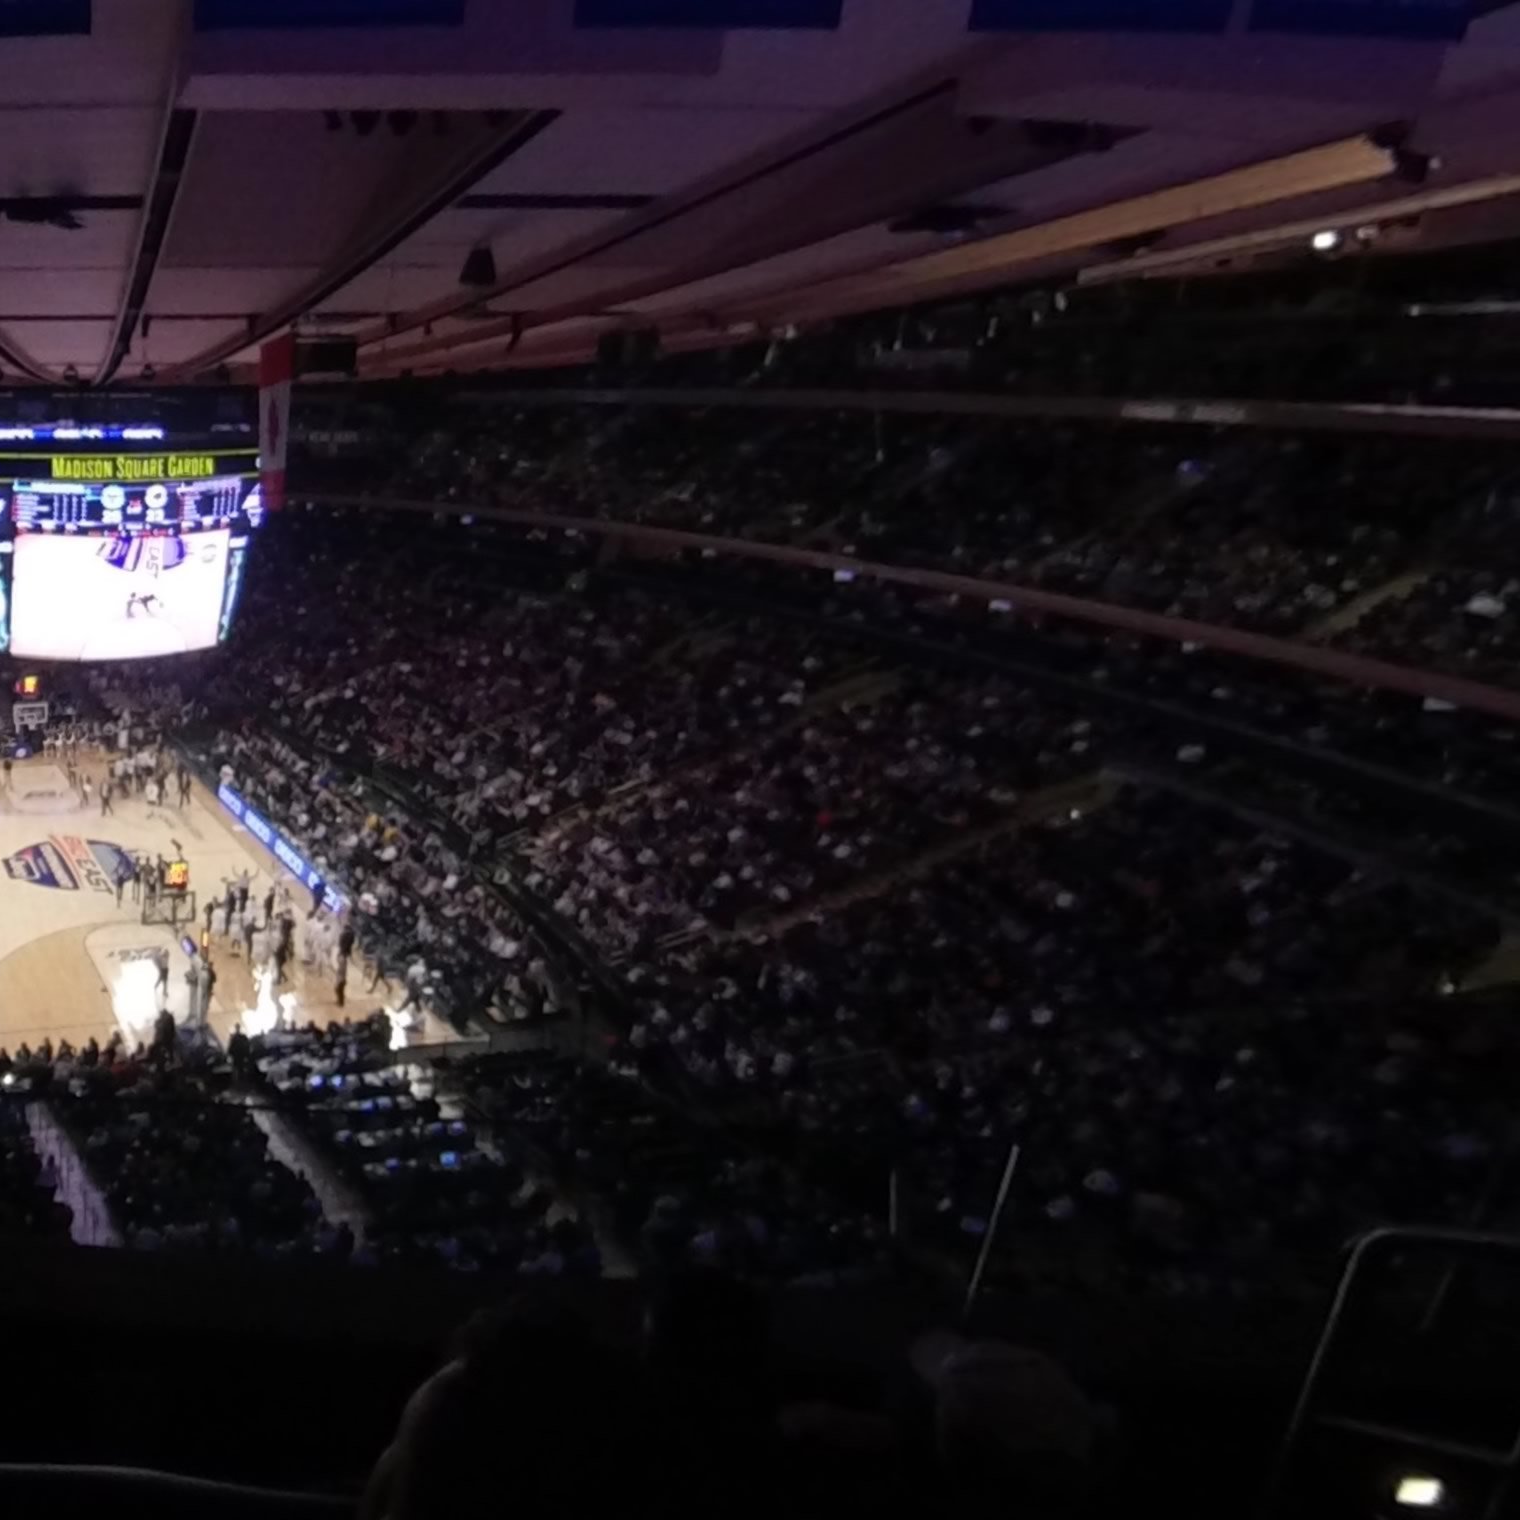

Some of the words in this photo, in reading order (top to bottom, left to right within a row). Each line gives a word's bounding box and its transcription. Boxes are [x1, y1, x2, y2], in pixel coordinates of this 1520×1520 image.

[52, 457, 113, 477] MADISON
[116, 456, 164, 478] SQUARE
[168, 456, 214, 477] GARDEN
[76, 858, 114, 895] EAST
